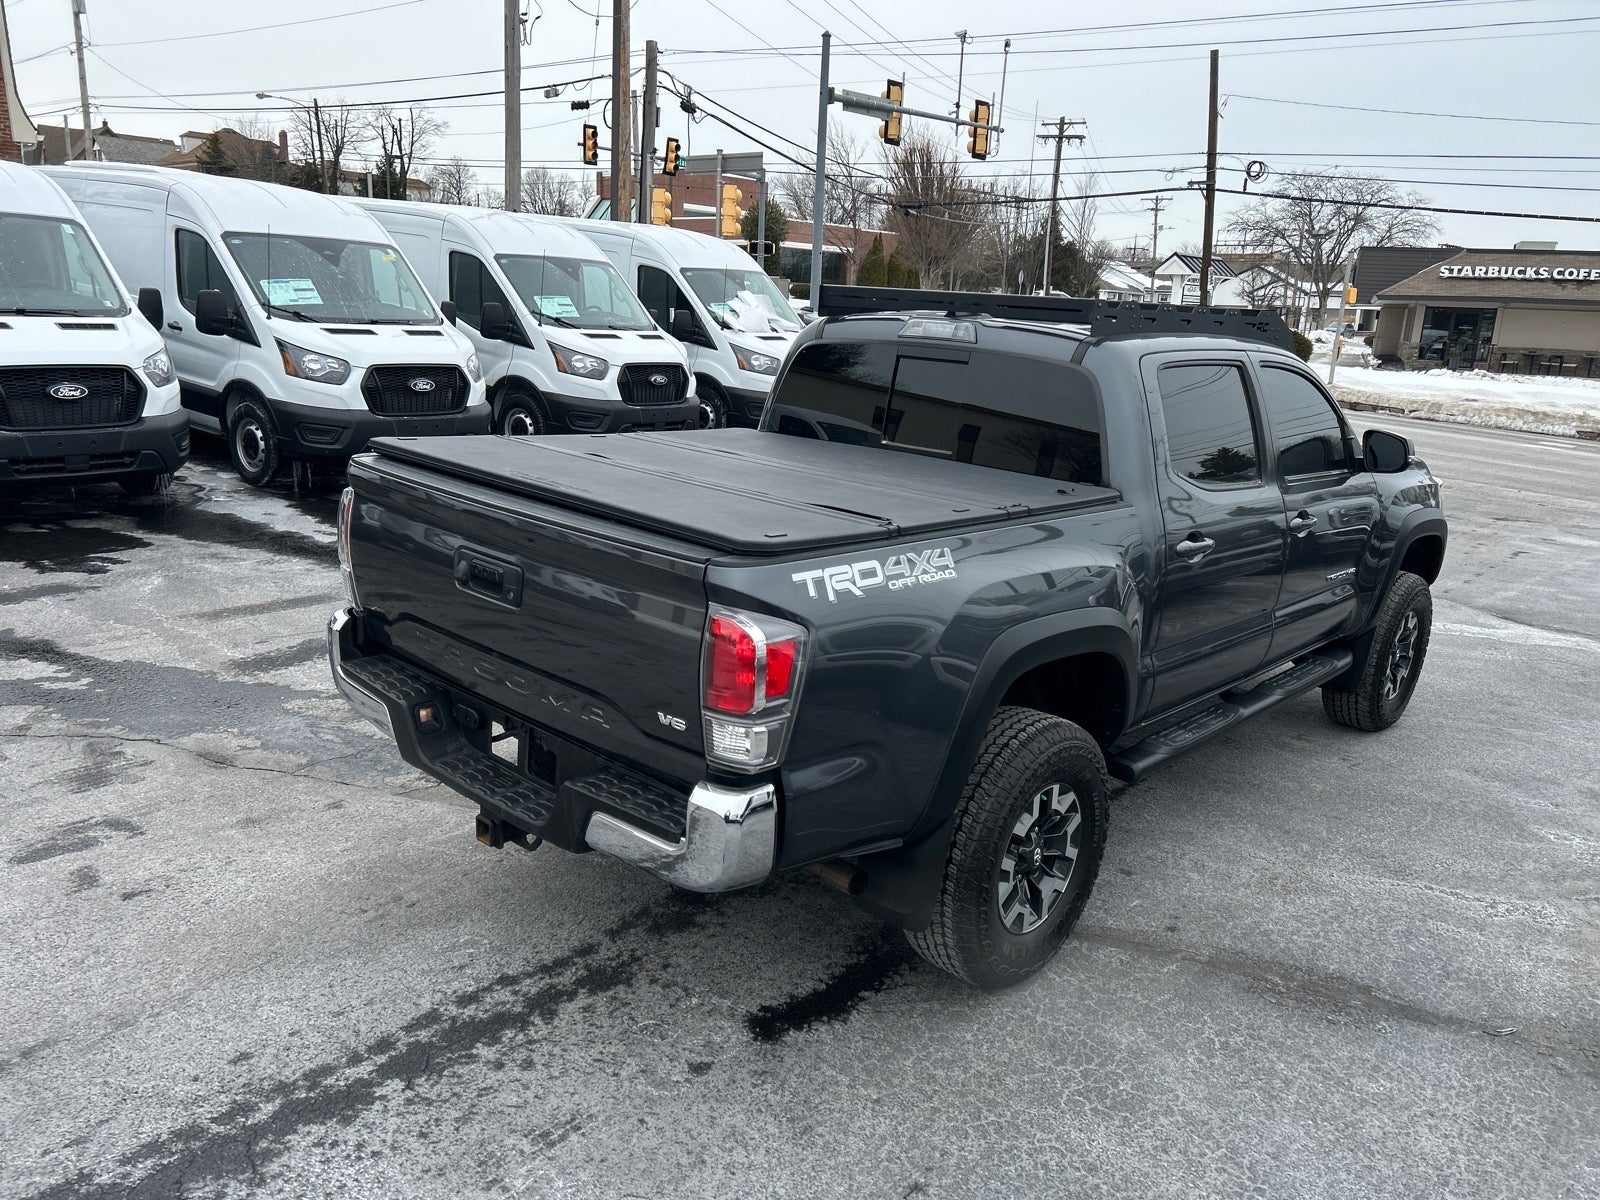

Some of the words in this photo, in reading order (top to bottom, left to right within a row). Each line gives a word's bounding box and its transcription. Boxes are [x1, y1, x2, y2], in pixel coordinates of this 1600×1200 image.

[1439, 265, 1549, 279] STARBUCKS
[791, 559, 886, 603] TRD
[887, 576, 916, 591] OFF
[917, 569, 957, 587] ROAD
[656, 710, 688, 732] V6
